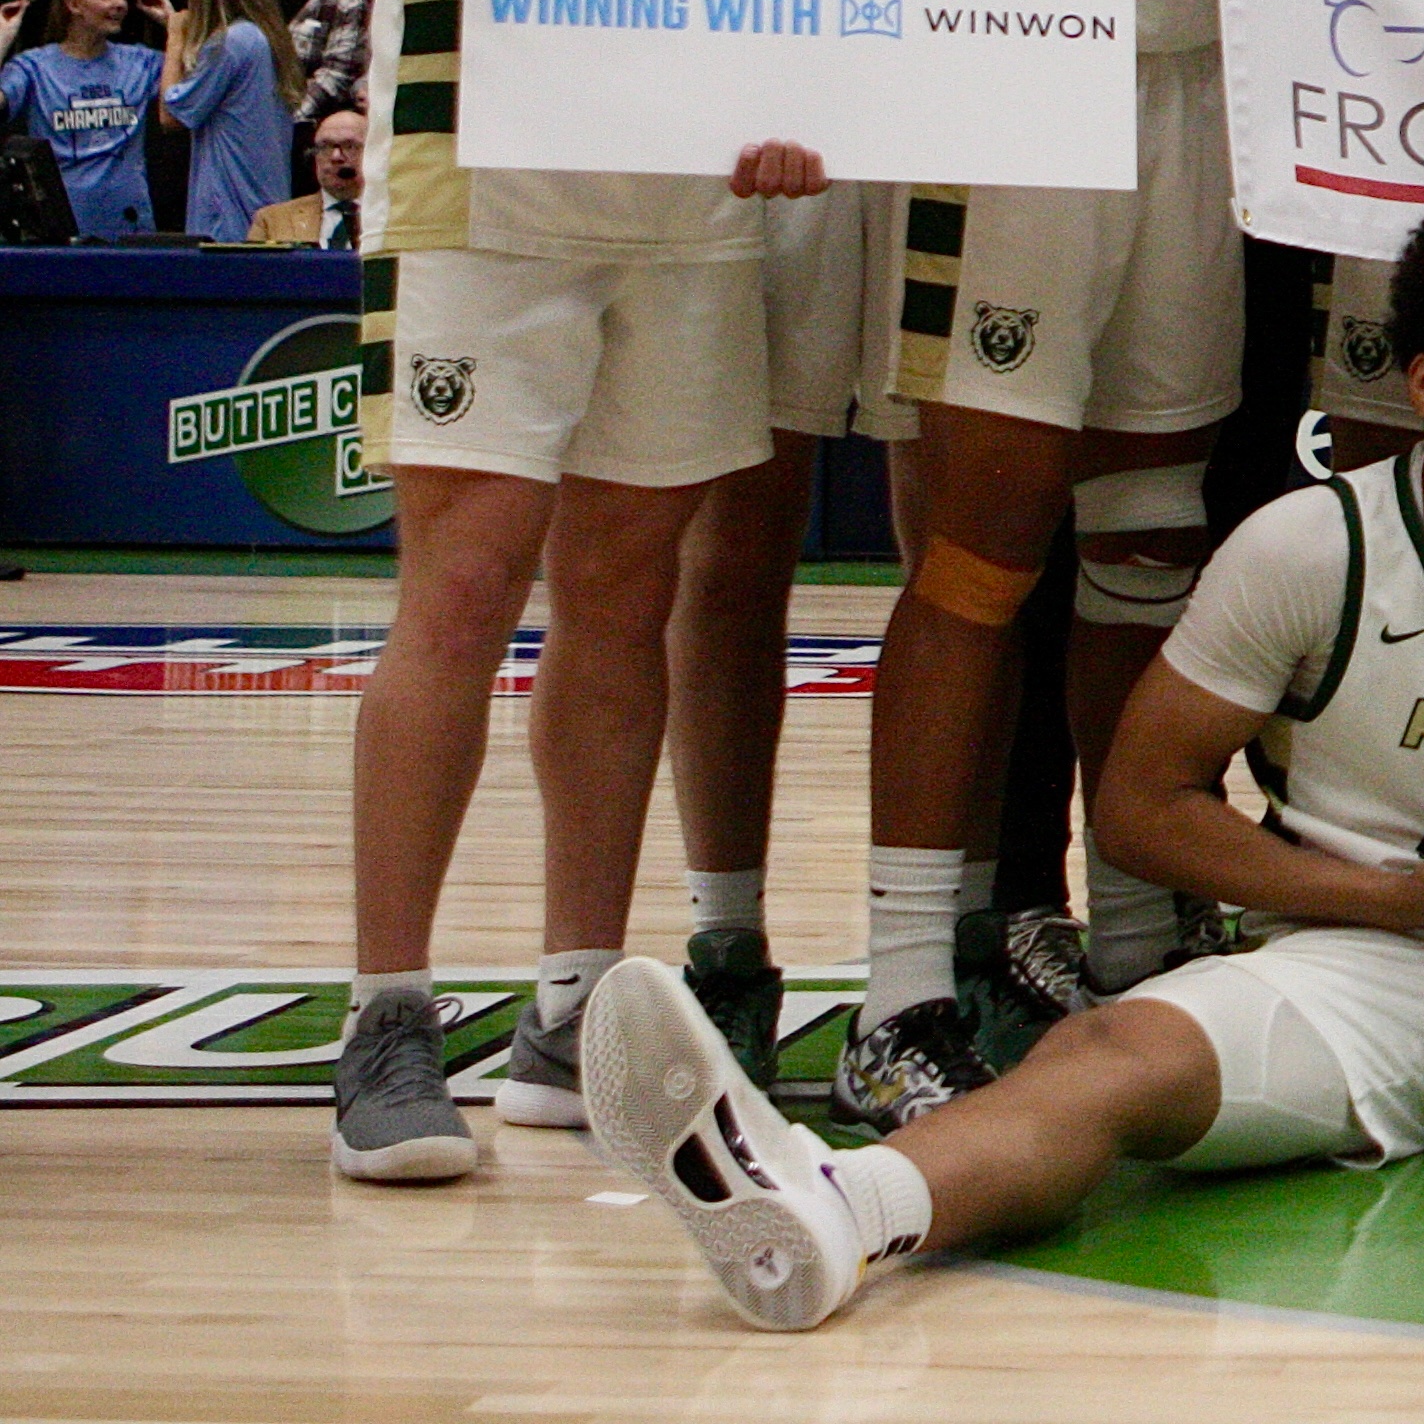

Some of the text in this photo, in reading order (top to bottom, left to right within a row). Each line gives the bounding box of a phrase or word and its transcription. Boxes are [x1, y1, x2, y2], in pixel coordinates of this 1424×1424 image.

[924, 7, 1116, 41] WINWON
[176, 380, 353, 449] BUTTE C
[342, 441, 364, 480] C
